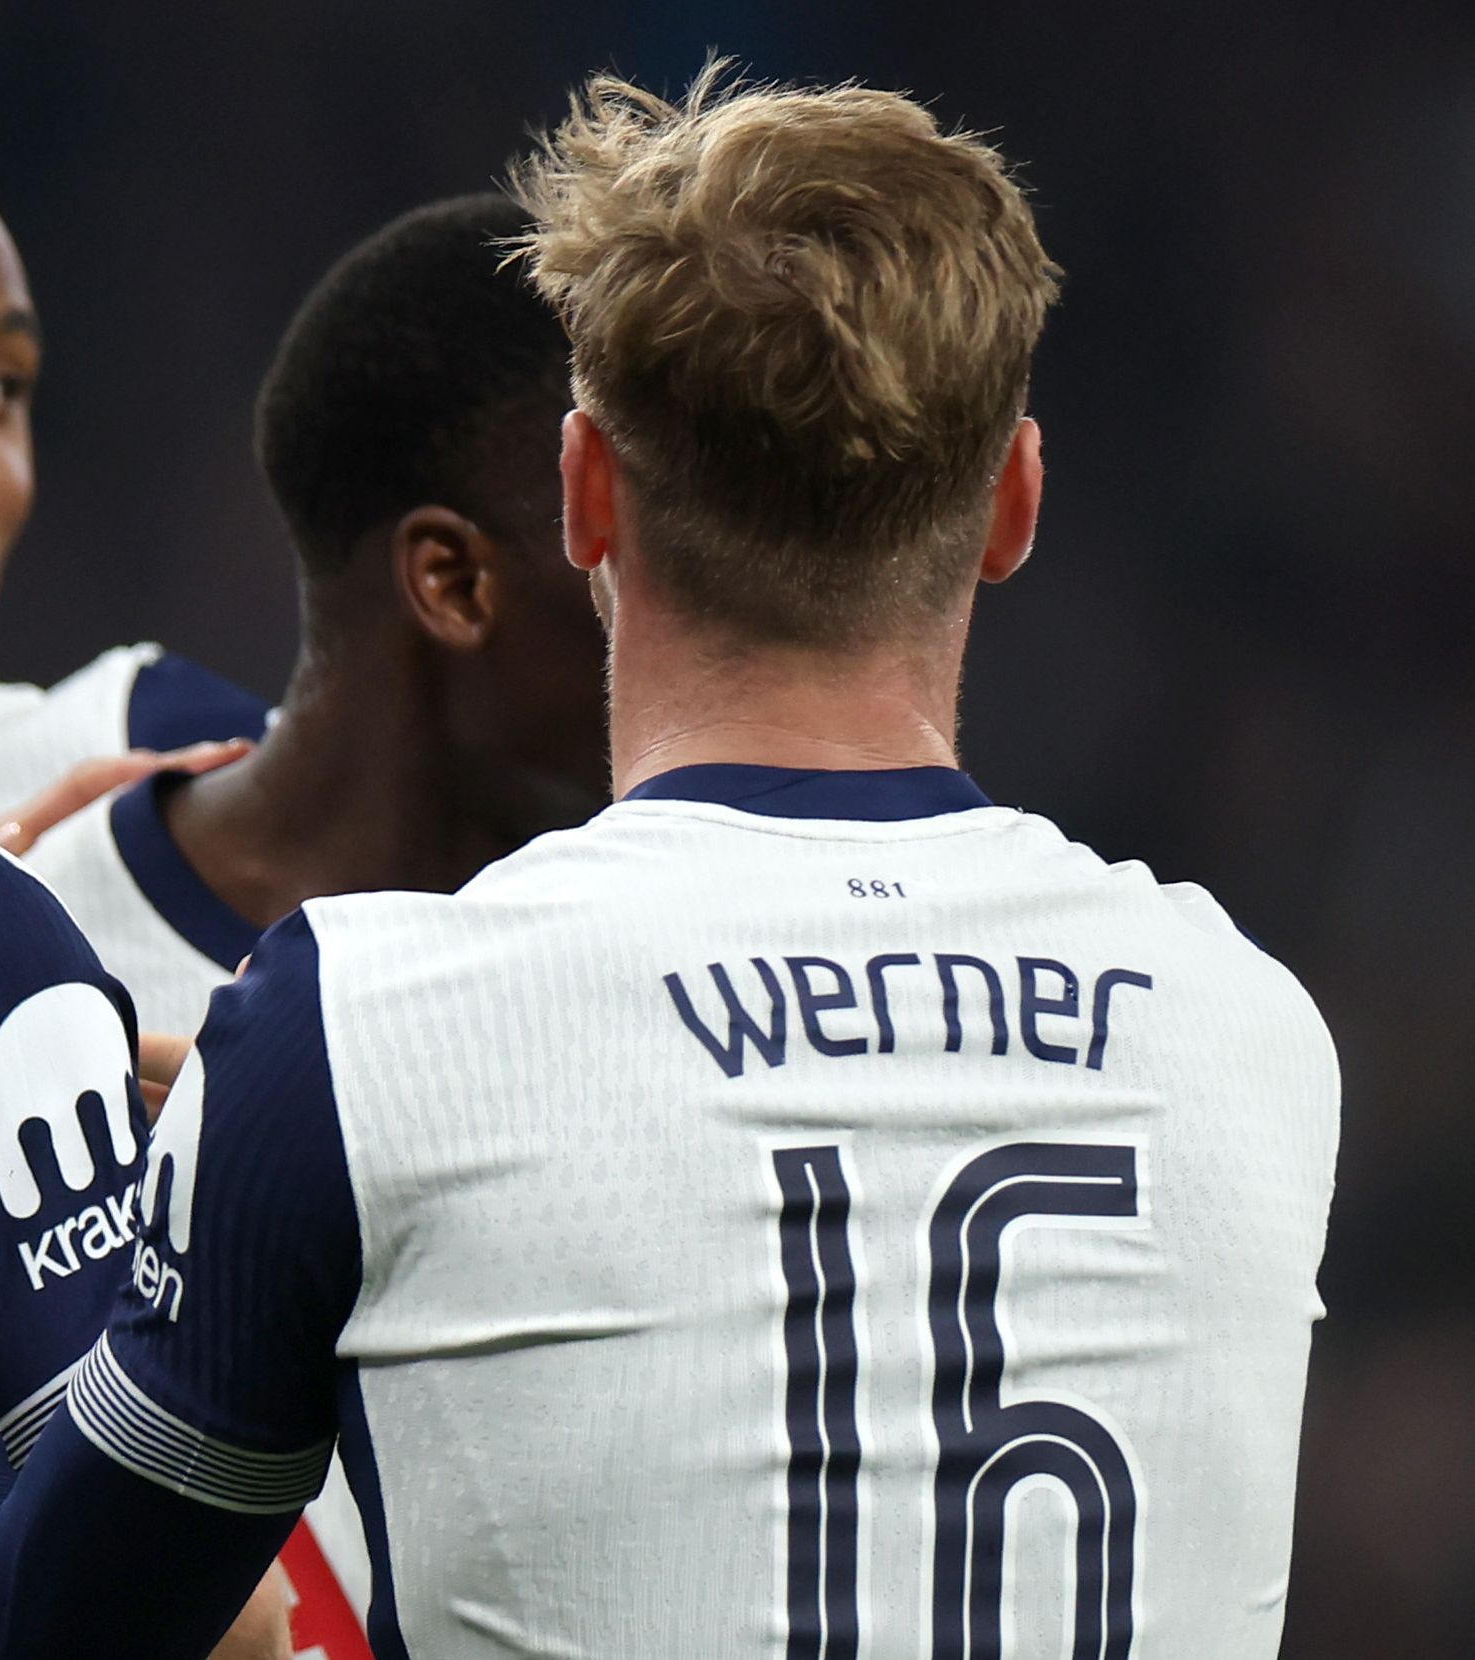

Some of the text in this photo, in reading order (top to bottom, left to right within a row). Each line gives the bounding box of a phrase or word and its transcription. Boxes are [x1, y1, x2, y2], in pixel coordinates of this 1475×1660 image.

[847, 878, 906, 898] 881
[663, 952, 1153, 1079] werner
[770, 1141, 1140, 1660] 16
